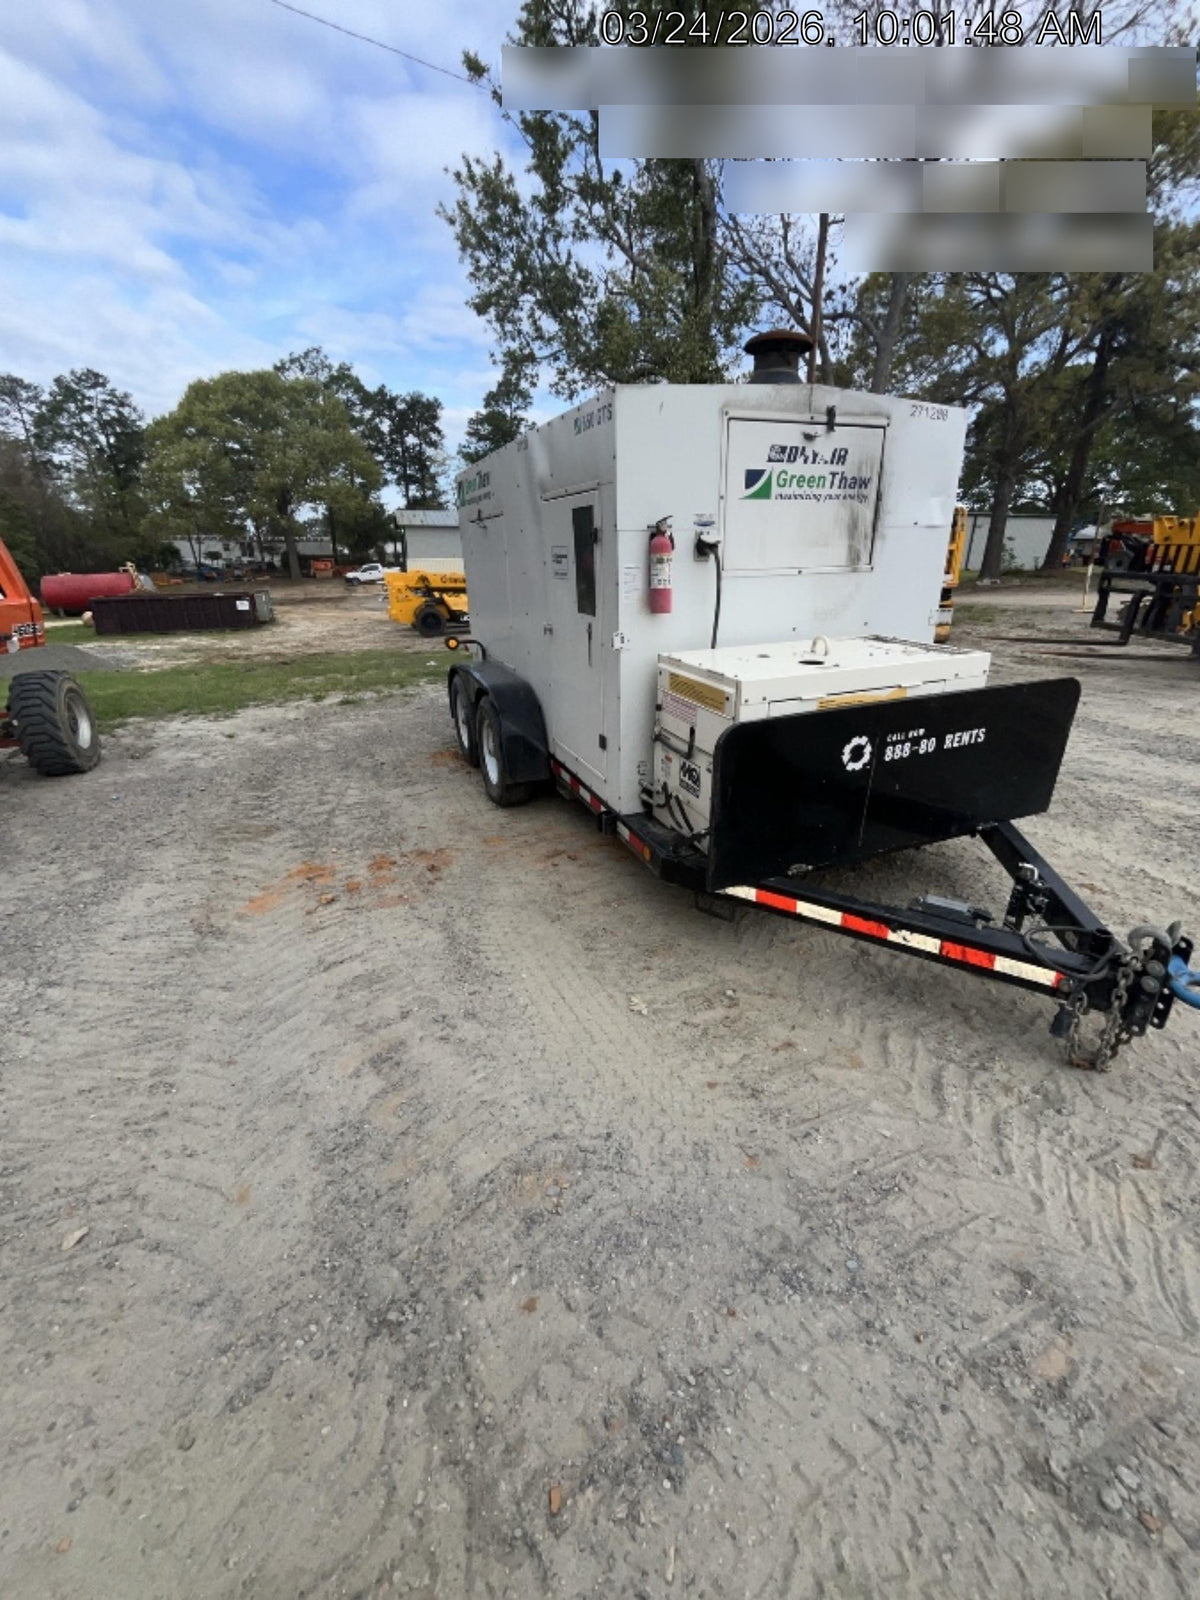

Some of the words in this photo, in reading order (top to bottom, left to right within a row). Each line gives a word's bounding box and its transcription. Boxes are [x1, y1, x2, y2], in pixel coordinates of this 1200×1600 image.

[776, 469, 826, 489] Green
[829, 470, 872, 490] Thaw
[884, 737, 936, 762] 888-80
[943, 728, 986, 749] RENTS
